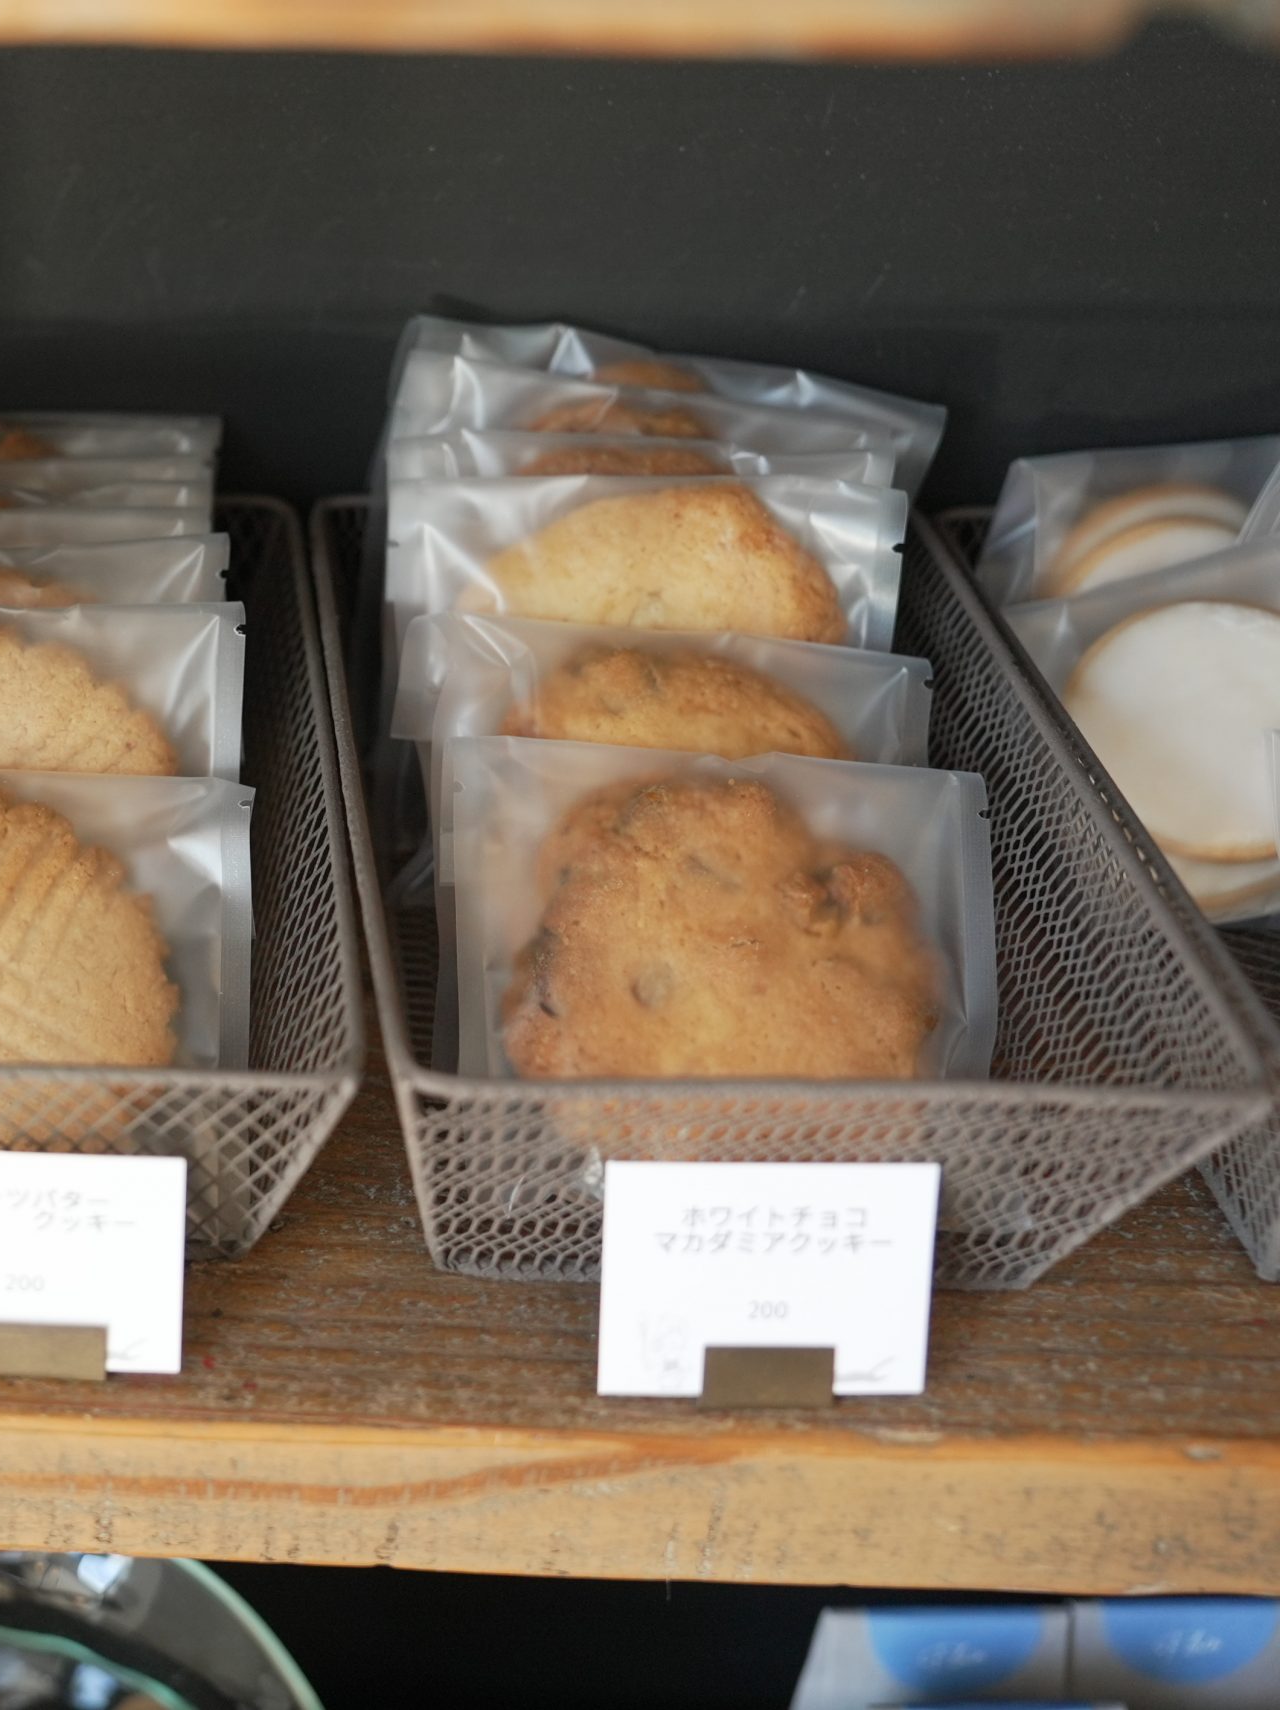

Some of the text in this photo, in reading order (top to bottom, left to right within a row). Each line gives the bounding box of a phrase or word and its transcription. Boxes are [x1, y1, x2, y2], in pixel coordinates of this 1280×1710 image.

[32, 1210, 136, 1233] クッキー
[681, 1204, 870, 1229] ホワイトチョコ
[654, 1230, 894, 1255] マカダミアクッキー
[4, 1273, 46, 1292] 200
[746, 1299, 790, 1321] 200
